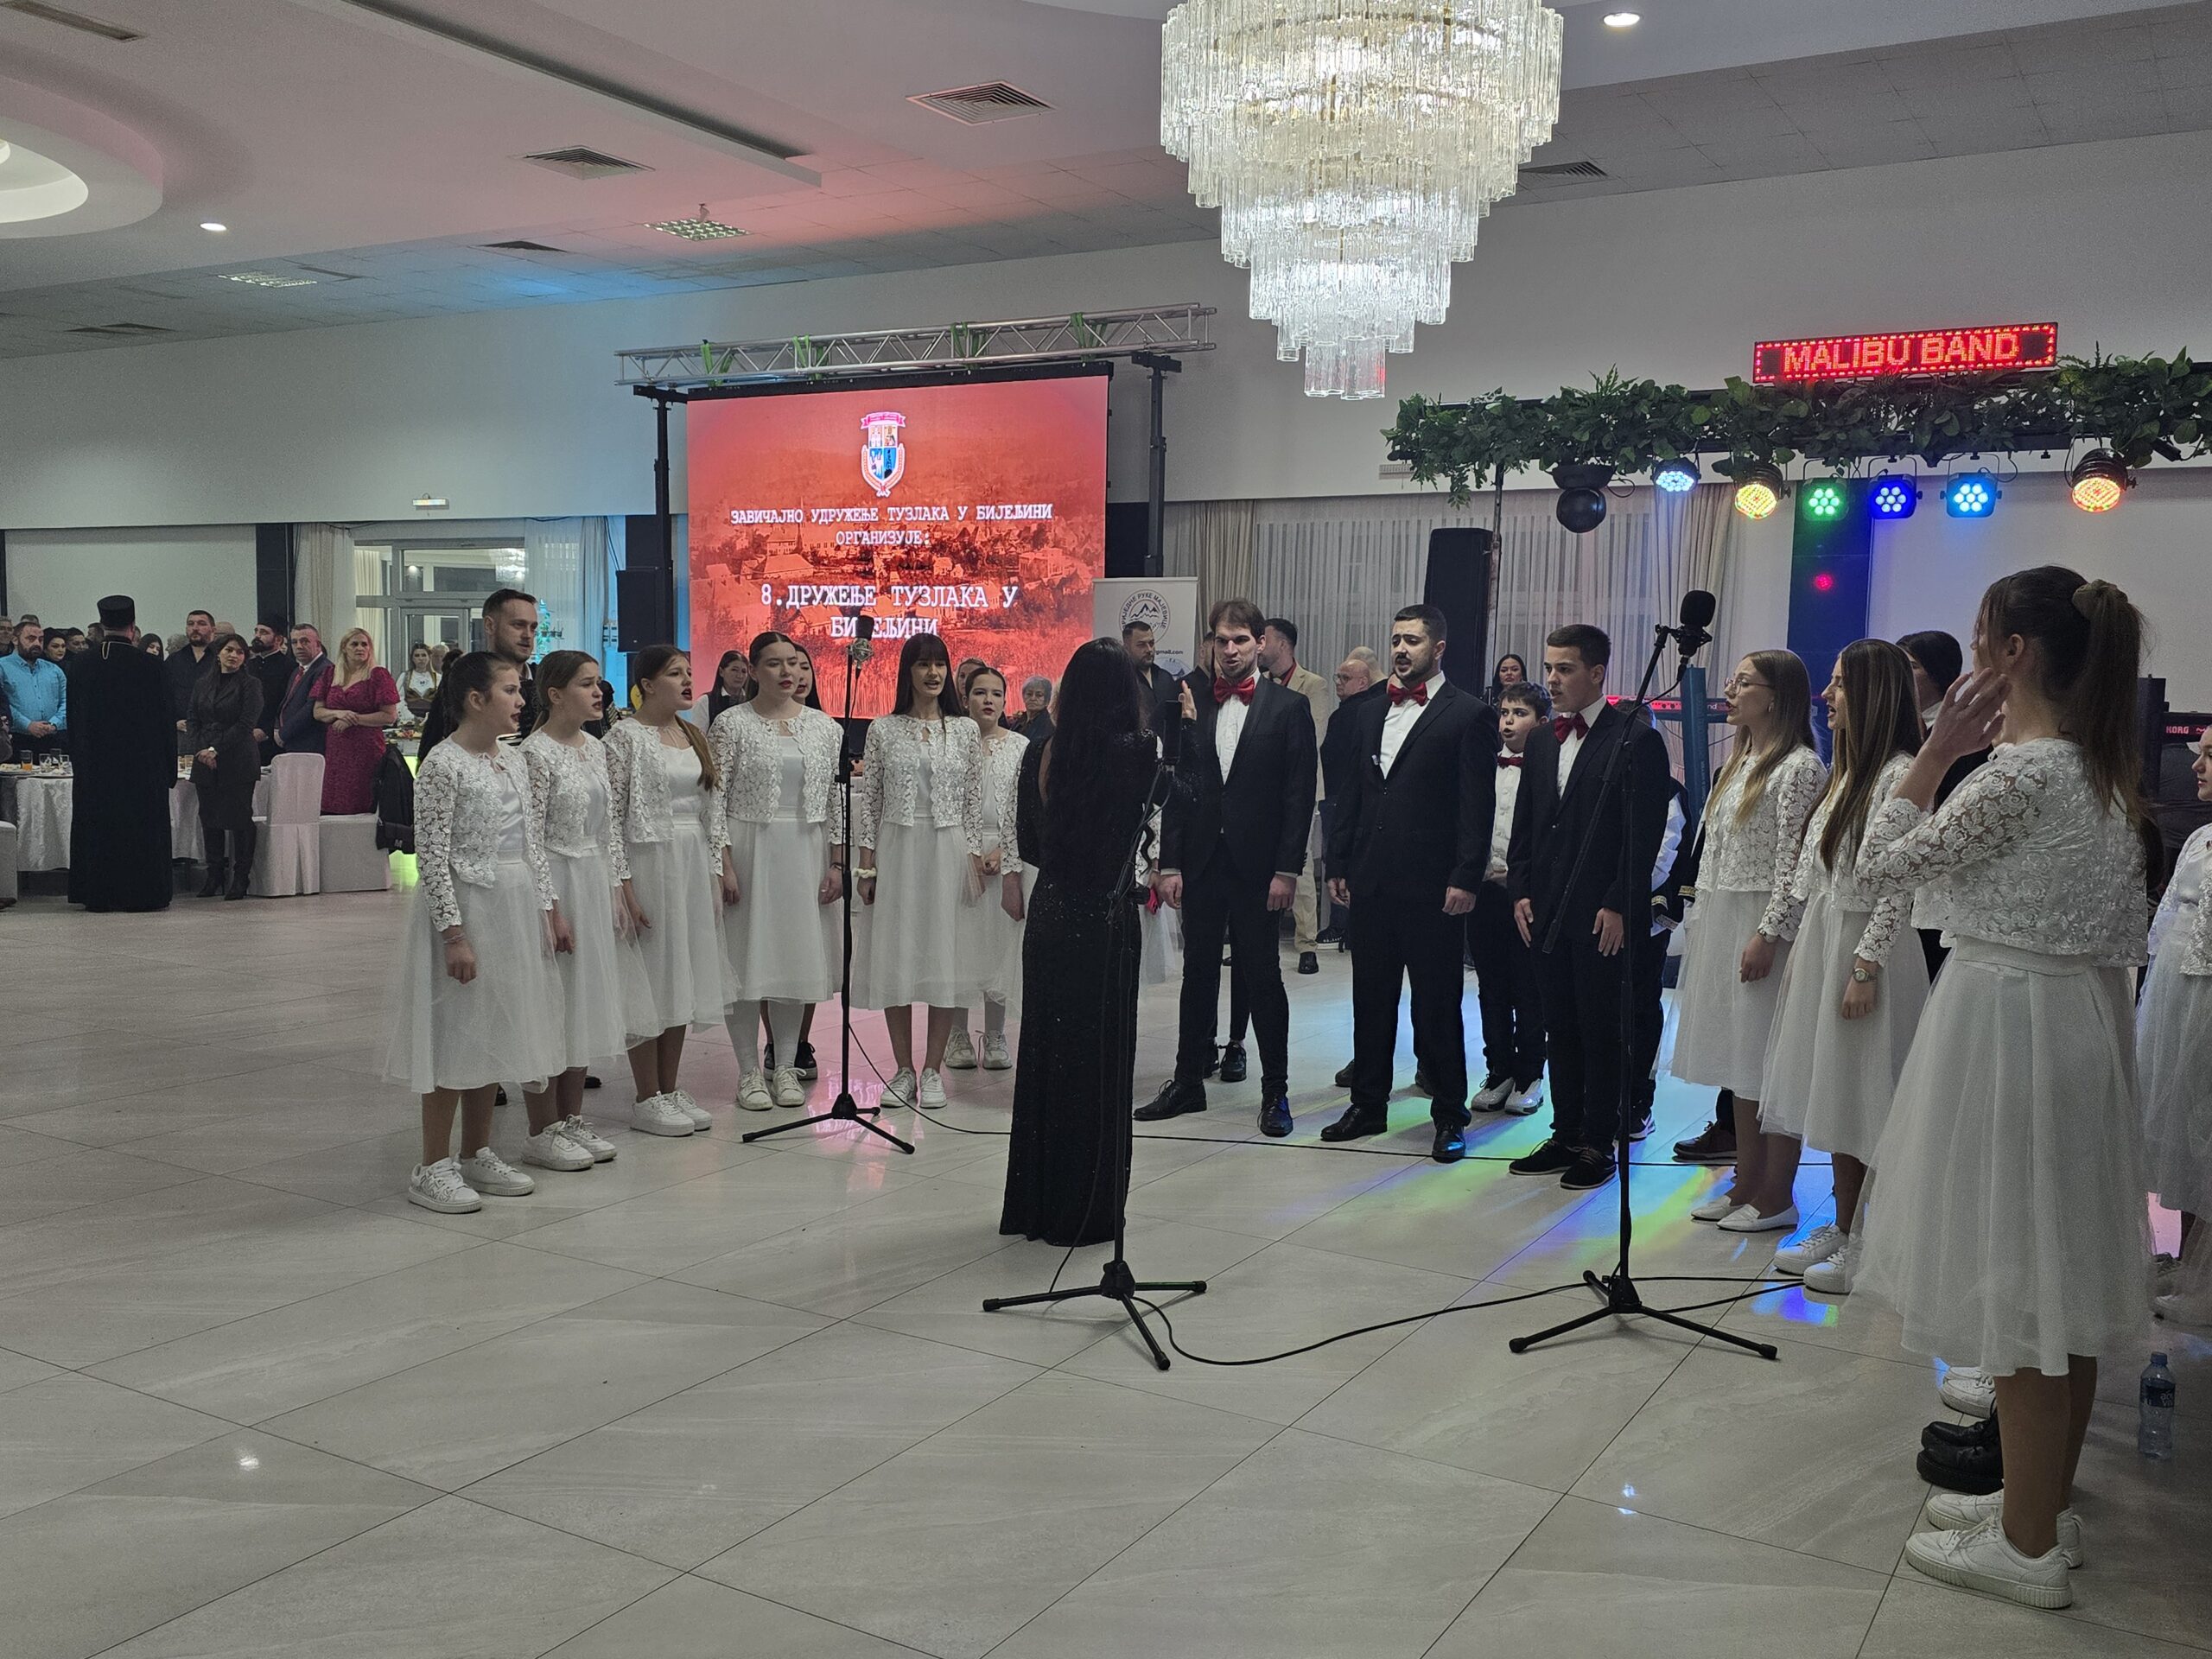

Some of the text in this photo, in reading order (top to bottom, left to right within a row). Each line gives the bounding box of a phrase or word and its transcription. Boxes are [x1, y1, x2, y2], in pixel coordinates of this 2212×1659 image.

[1784, 333, 2019, 372] MALIBU BAND
[730, 503, 1053, 524] ЗАВИЧАЈНО УДРУЖЕЊЕ ТУЗЛАКА У БИЈЕЉИНИ
[836, 530, 931, 546] ОРГАНИЗУЈЕ:
[891, 585, 988, 607] ТУЗЛАКА
[1002, 586, 1018, 608] У
[830, 616, 938, 638] БИЕЉИНИ
